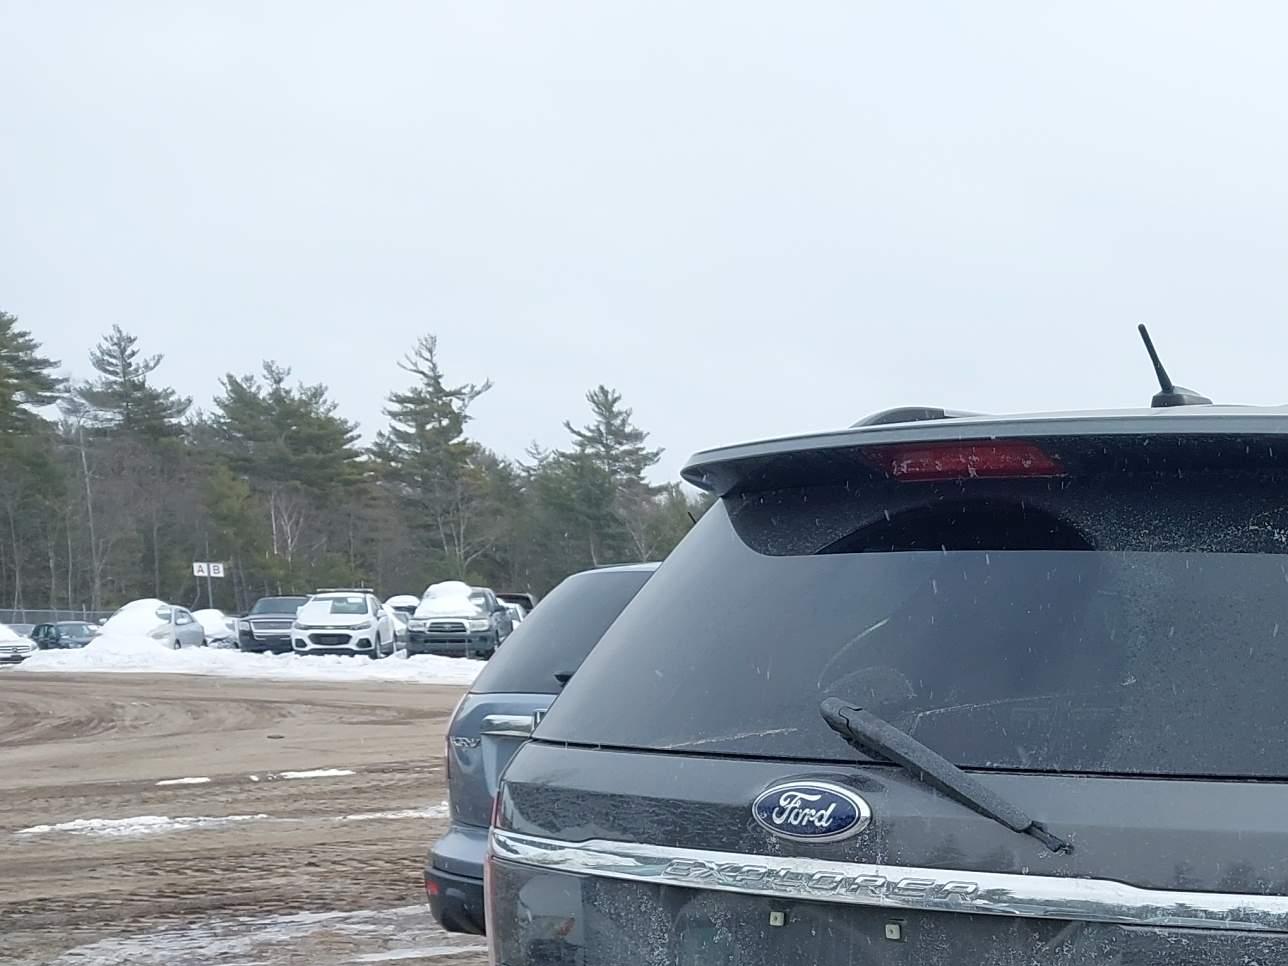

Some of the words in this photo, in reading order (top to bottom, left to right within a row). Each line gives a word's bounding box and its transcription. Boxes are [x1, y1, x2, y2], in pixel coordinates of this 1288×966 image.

[196, 564, 205, 575] A
[212, 565, 221, 575] B
[772, 791, 837, 827] Ford
[661, 857, 979, 902] EXPLORER
